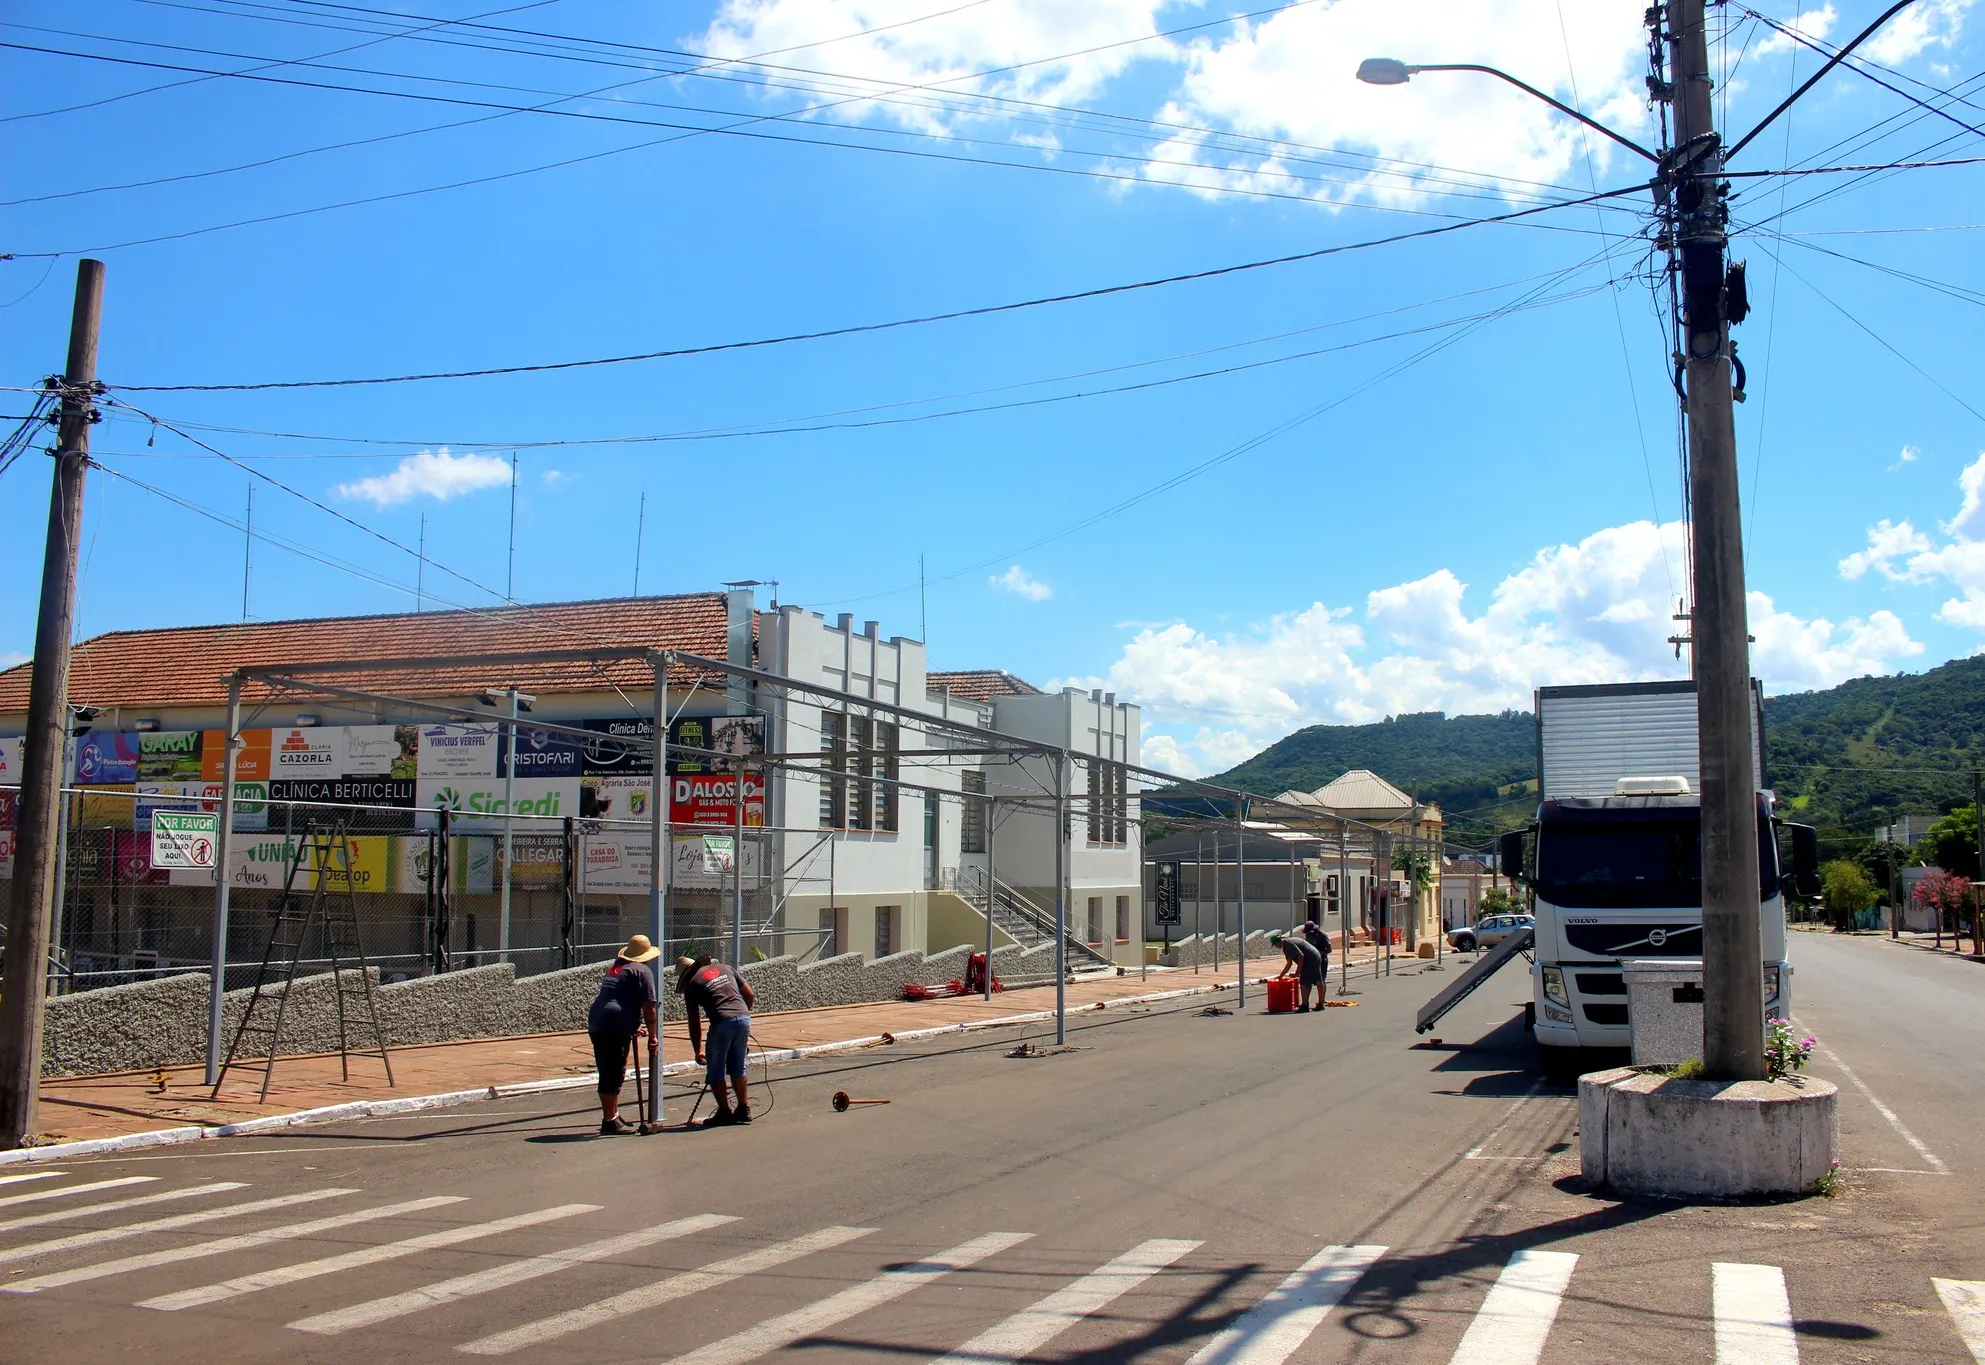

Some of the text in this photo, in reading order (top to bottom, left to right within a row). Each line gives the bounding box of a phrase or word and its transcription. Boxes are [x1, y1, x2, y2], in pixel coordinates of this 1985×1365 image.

[609, 723, 636, 735] Clínica
[141, 732, 199, 753] GARAY
[430, 736, 486, 747] VINICIUS VERFFEL
[280, 754, 332, 763] CAZORLA
[238, 760, 257, 769] LÚCIA
[271, 781, 413, 798] CLÍNICA BERTICELLI
[582, 779, 600, 789] Coop.
[623, 779, 635, 787] São
[637, 779, 652, 787] José
[204, 785, 261, 801] FARÁCIA
[675, 780, 757, 804] DALOSO
[157, 817, 213, 830] POR FAVOR
[172, 833, 193, 841] JOGUE
[498, 837, 536, 846] MEIREIRA
[159, 842, 173, 850] SEU
[258, 838, 308, 863] UNIÃO
[590, 847, 606, 856] CASA
[497, 848, 564, 863] CLLEGAR
[586, 855, 619, 864] PARABRISA
[235, 865, 268, 886] Anos
